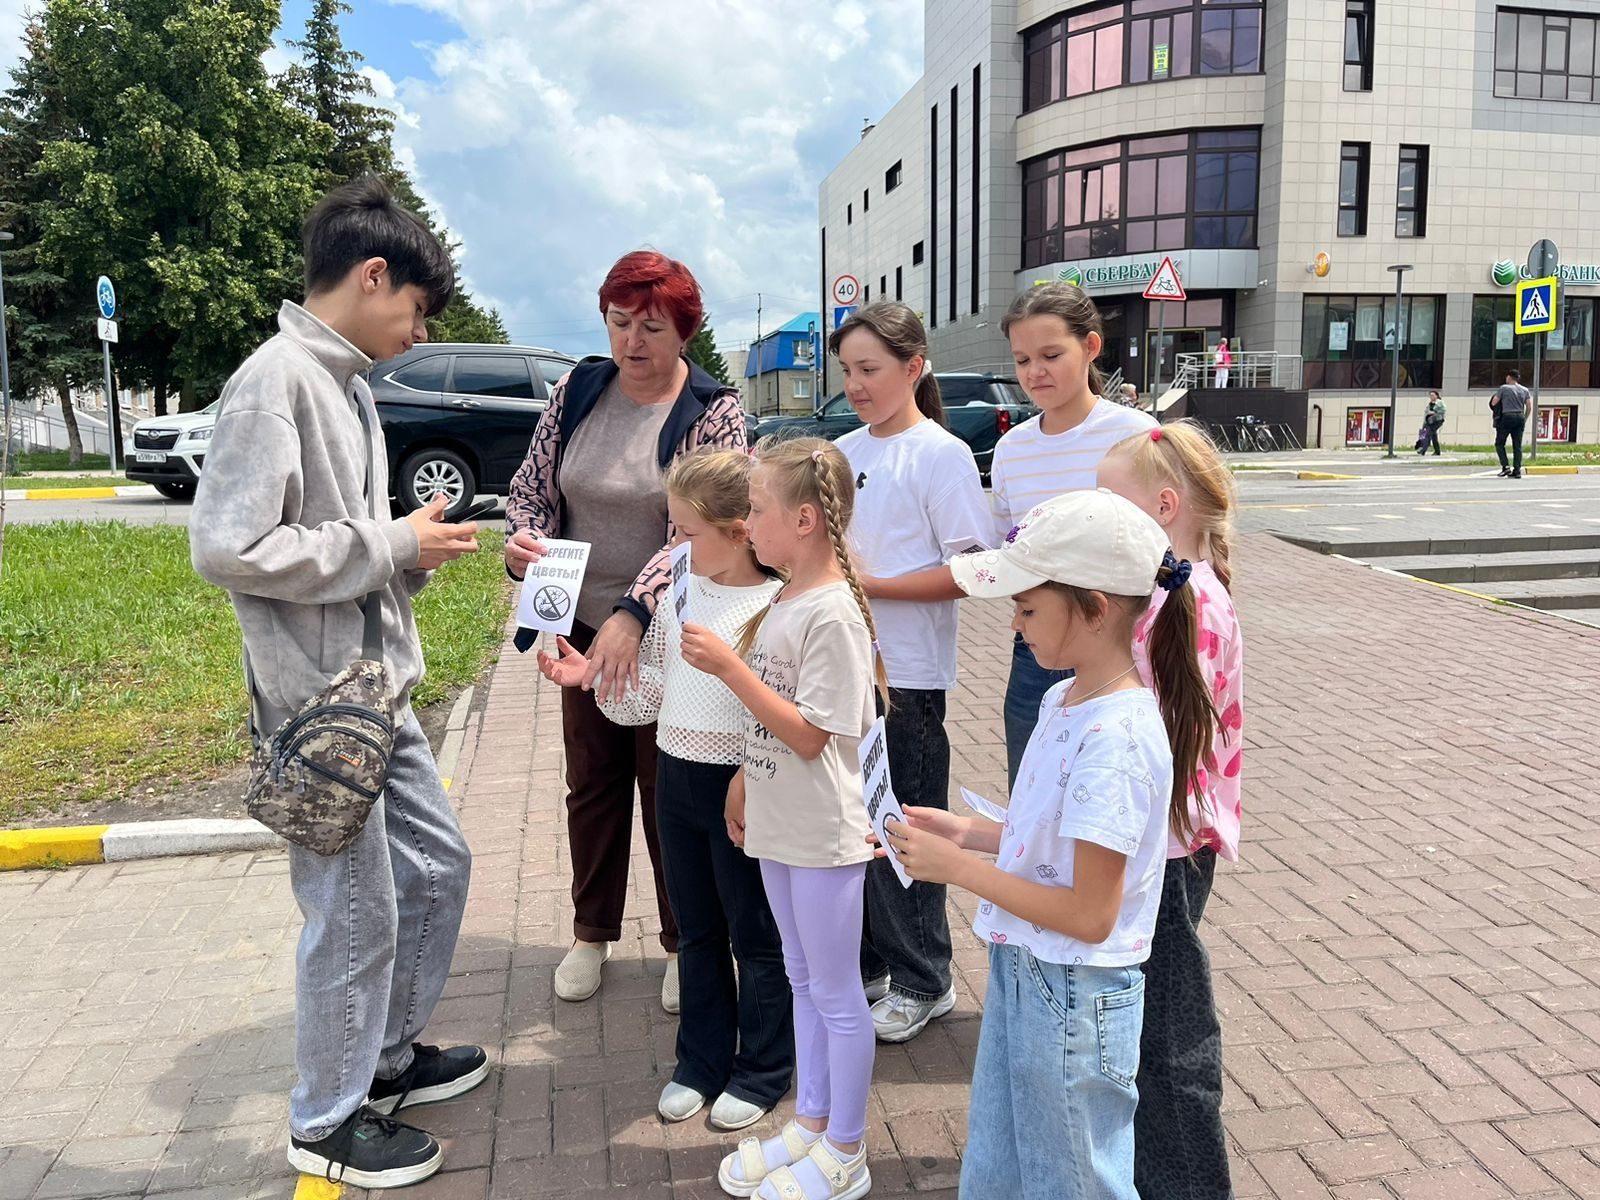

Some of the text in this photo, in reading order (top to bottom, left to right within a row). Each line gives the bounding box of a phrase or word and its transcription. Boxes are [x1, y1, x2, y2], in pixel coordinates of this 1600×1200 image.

[838, 284, 854, 296] 40
[541, 547, 585, 561] ЕРЕГИТЕ
[863, 732, 884, 785] БЕРЕГИТЕ
